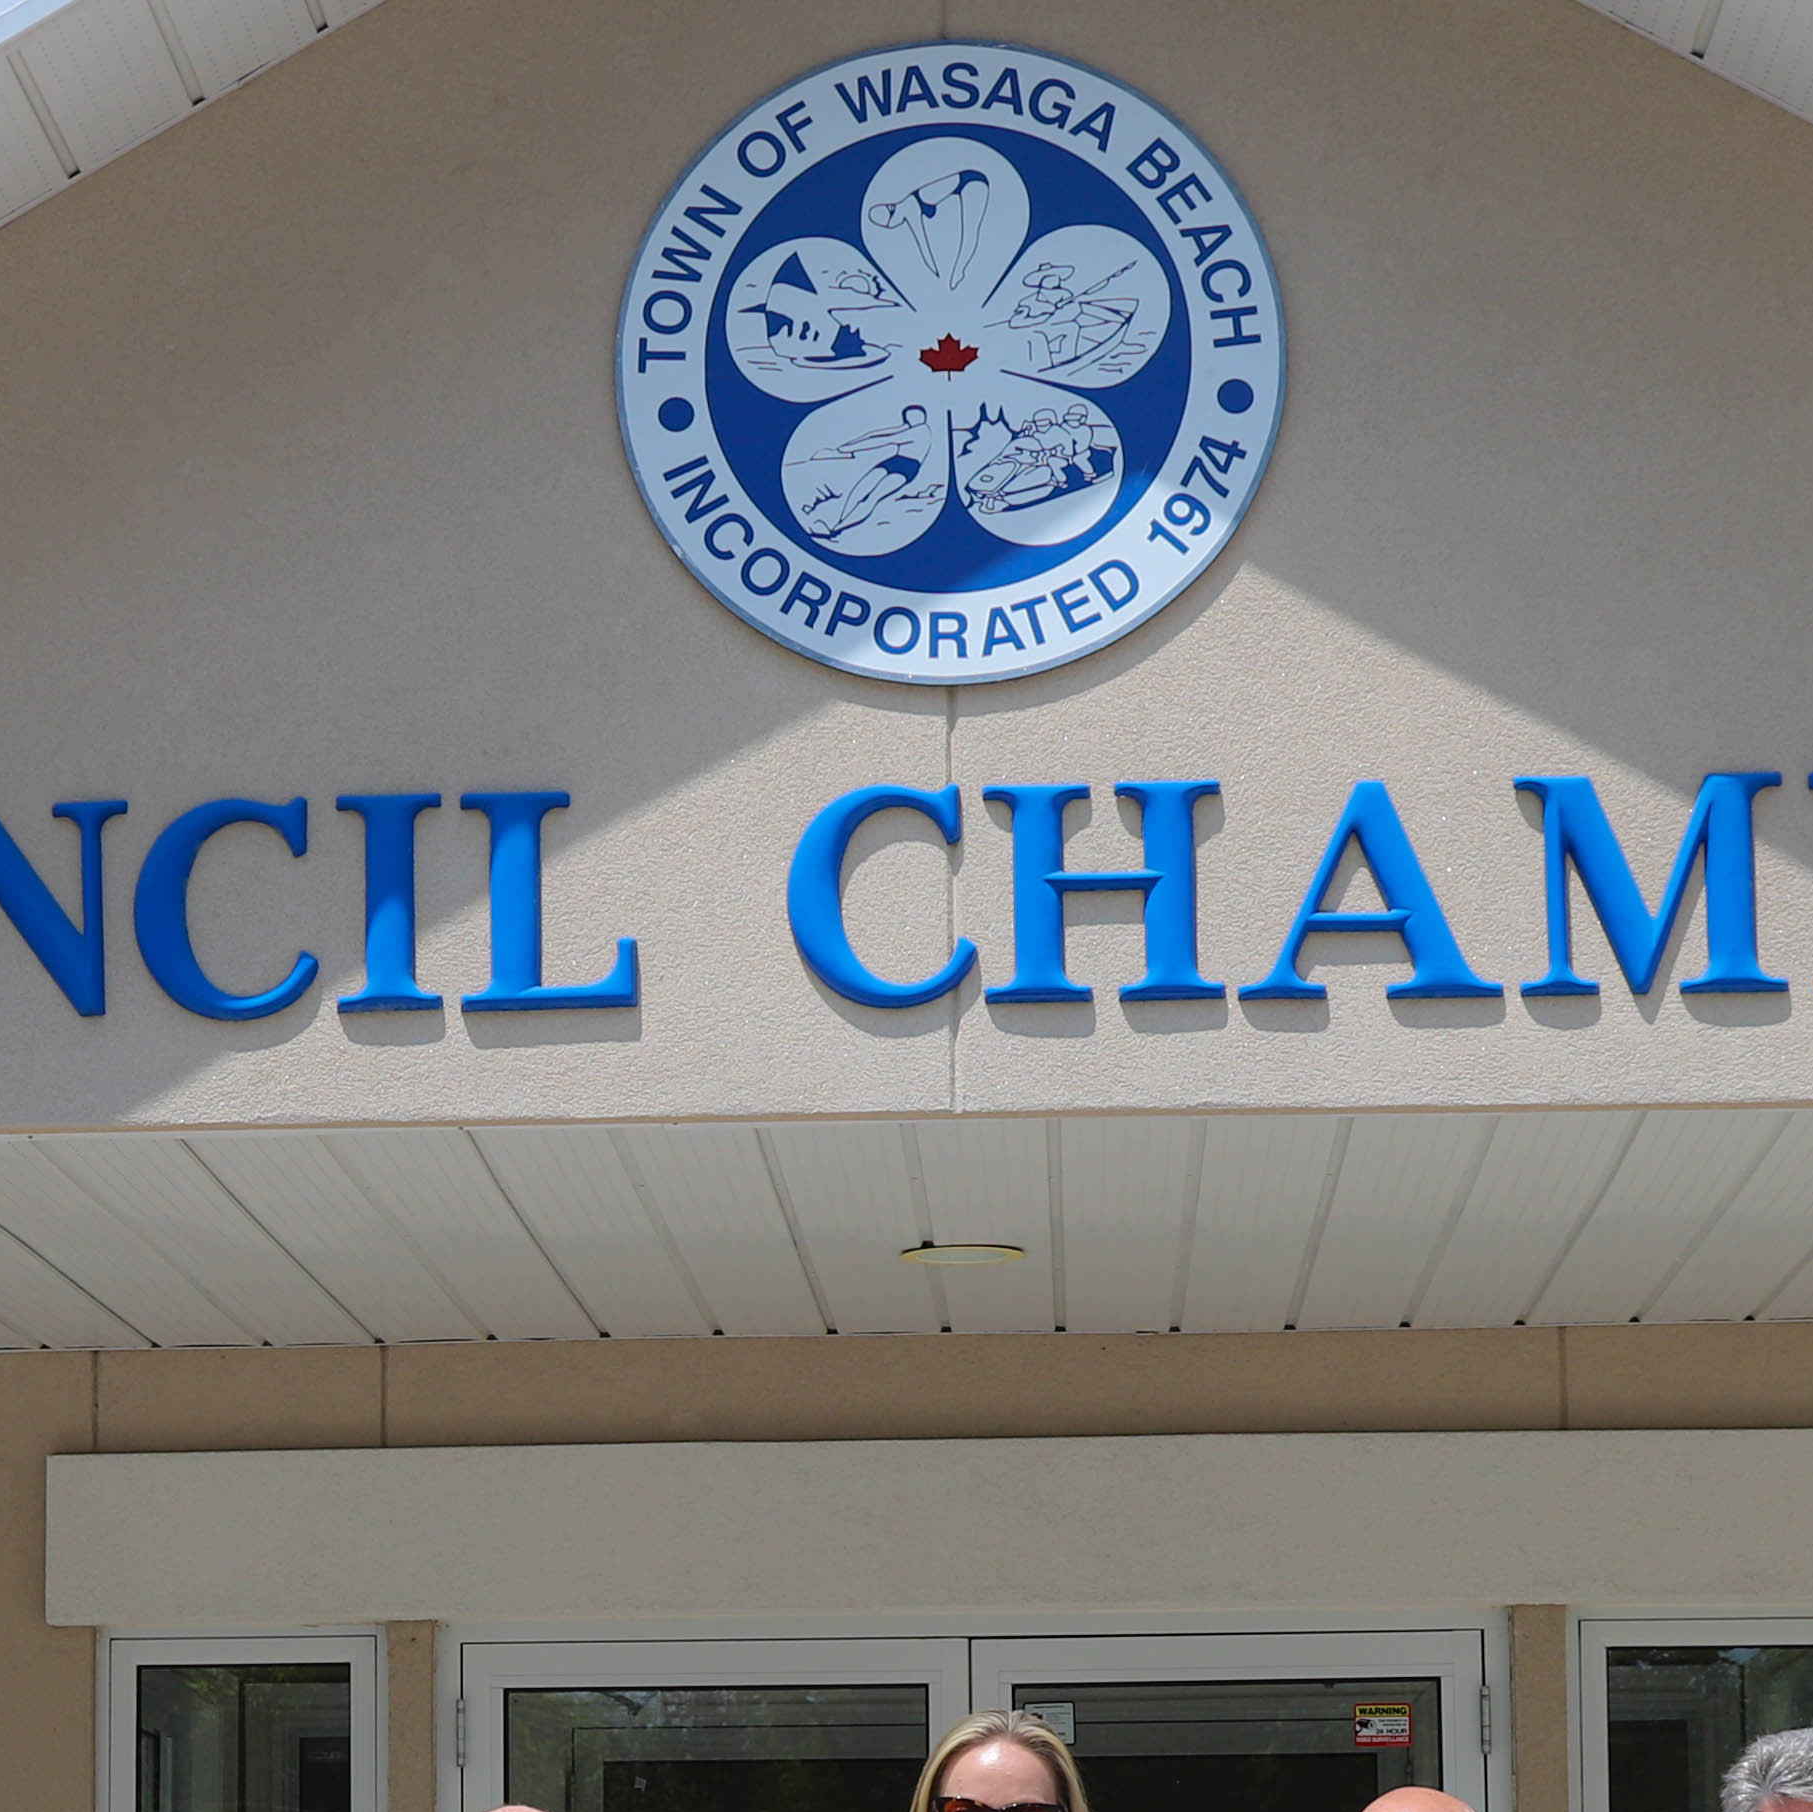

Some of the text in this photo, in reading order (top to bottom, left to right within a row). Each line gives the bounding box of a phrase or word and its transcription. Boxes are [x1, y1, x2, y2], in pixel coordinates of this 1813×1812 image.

[638, 62, 1262, 373] TOWN OF WASAGA BEACH
[662, 435, 1248, 659] INCORPORATED 1974
[1358, 1707, 1407, 1715] WARNING
